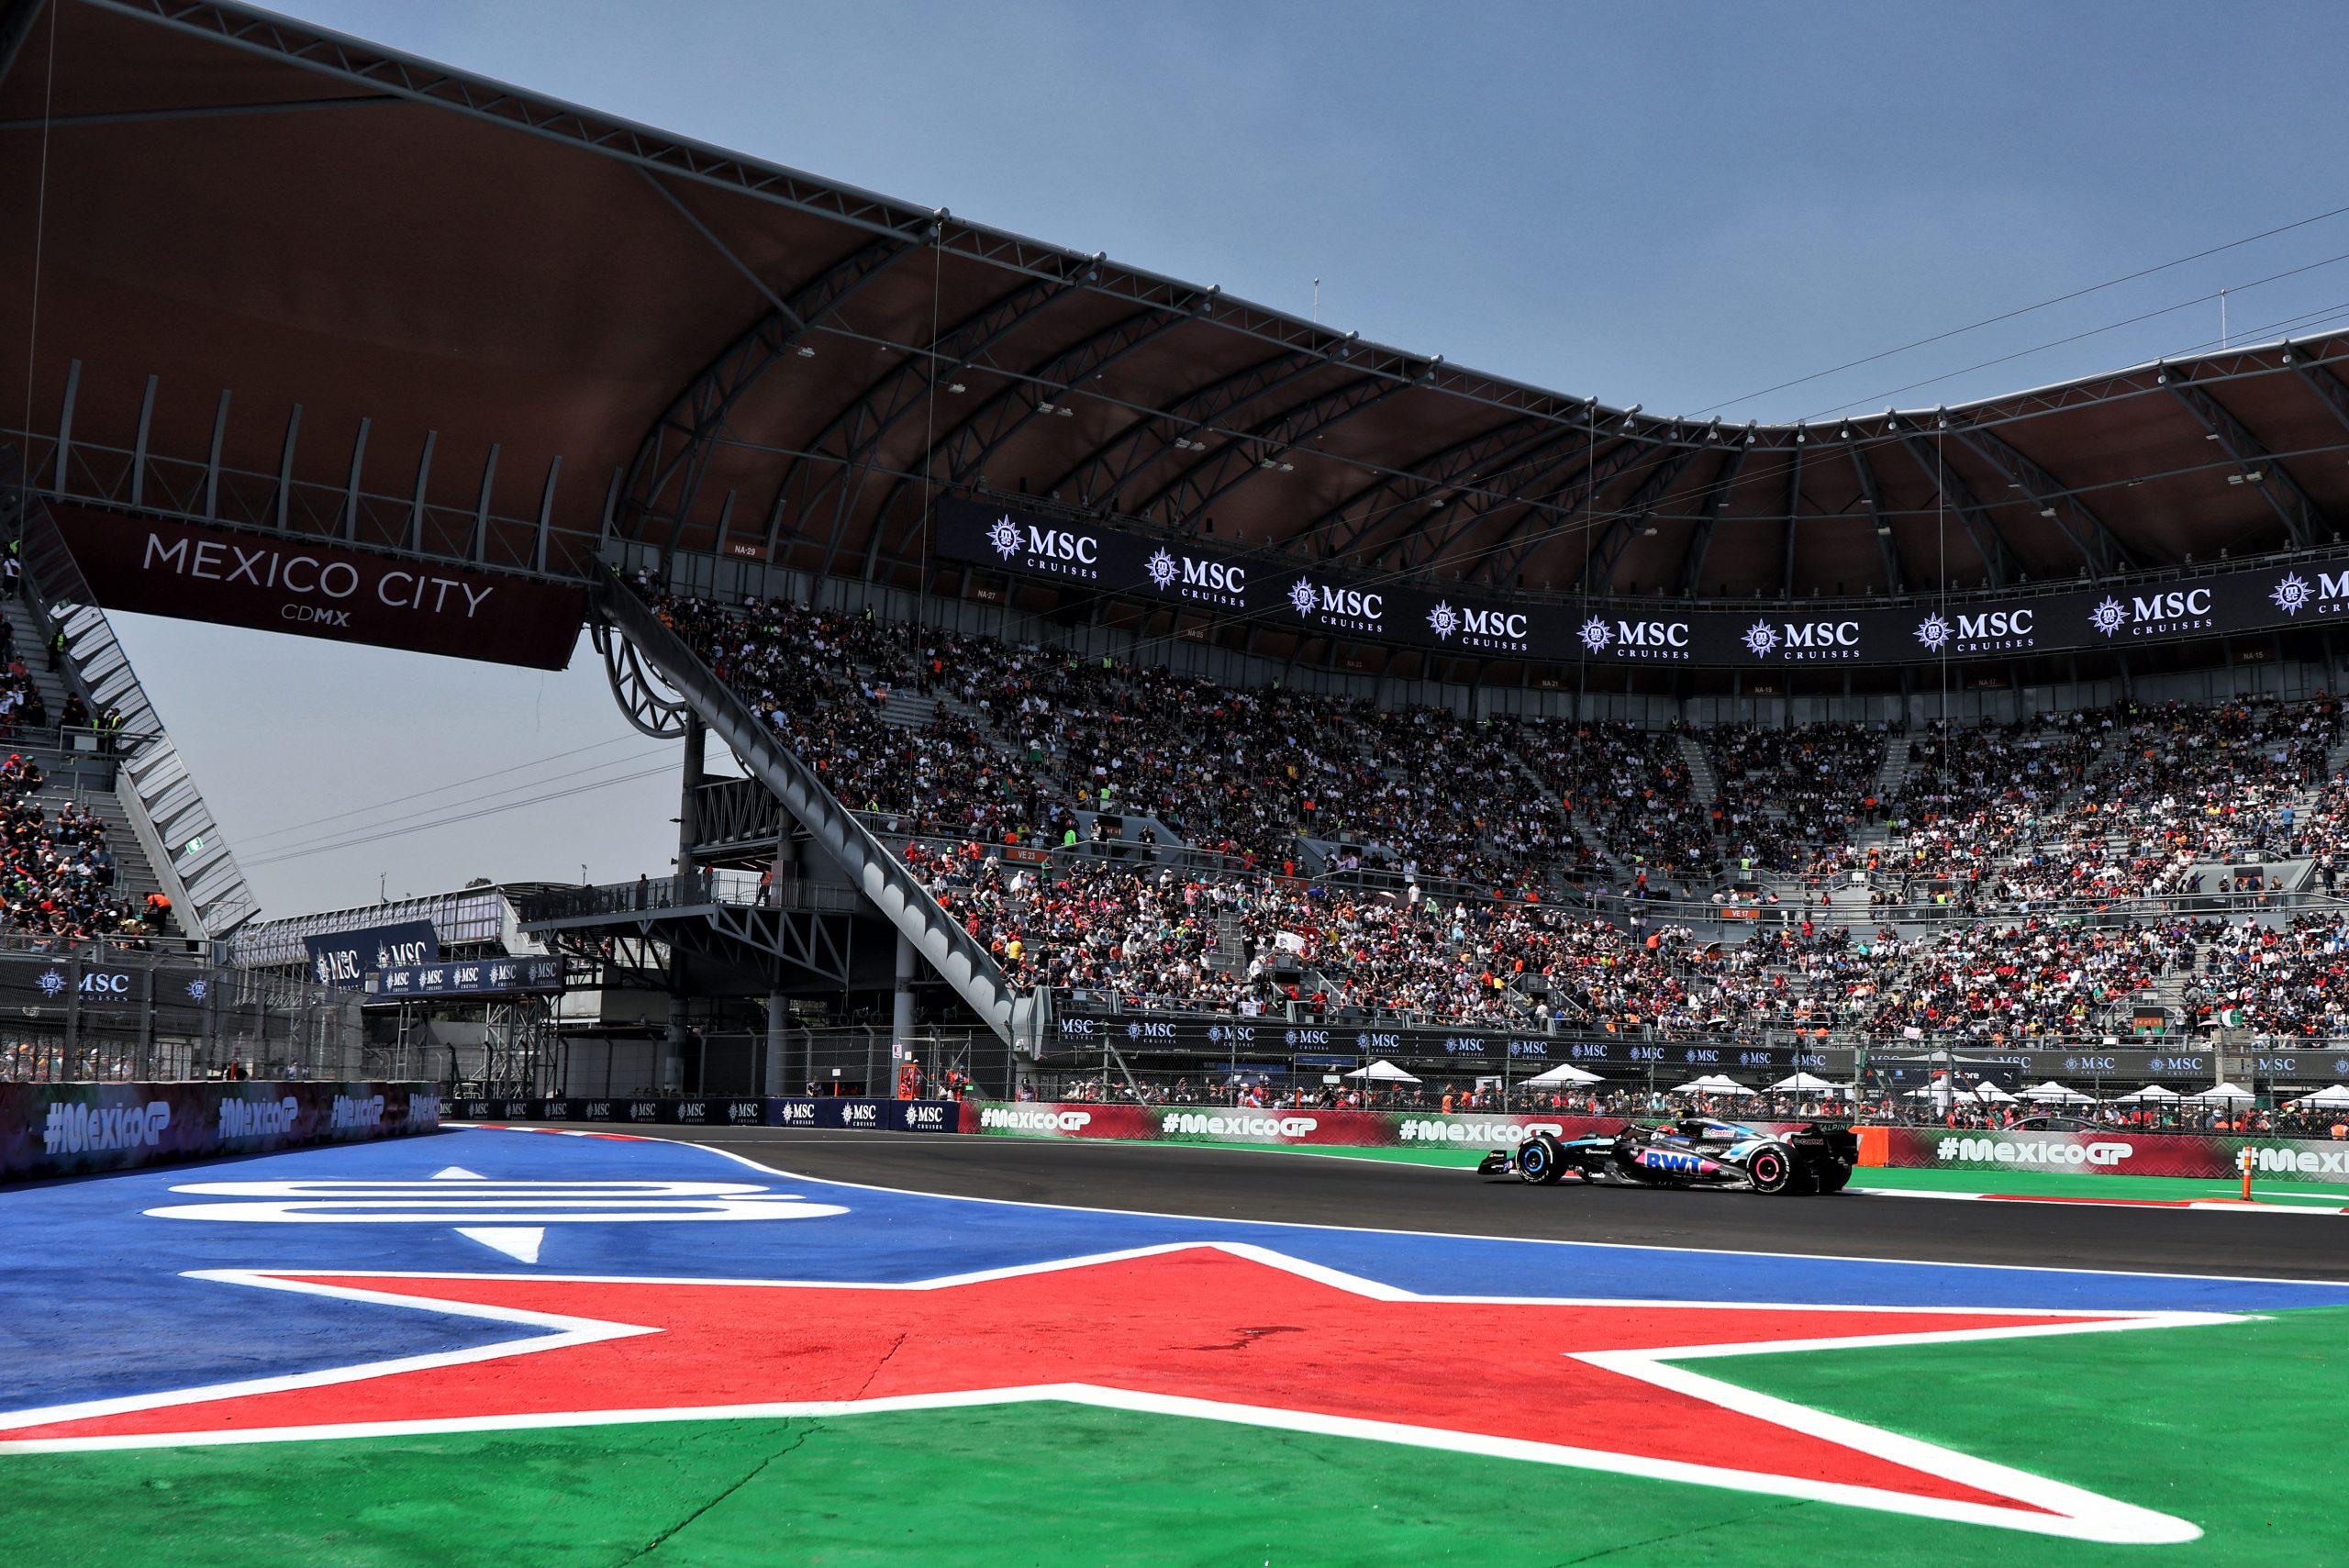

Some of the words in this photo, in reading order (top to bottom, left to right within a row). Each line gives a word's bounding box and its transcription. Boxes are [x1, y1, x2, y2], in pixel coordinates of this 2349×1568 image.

[1028, 525, 1097, 563] MSC
[143, 533, 359, 598] MEXICO
[378, 571, 494, 618] CITY
[1028, 559, 1097, 579] CRUISES
[1182, 556, 1245, 593] MSC
[1182, 588, 1245, 607] CRUISES
[1321, 585, 1383, 619] MSC
[2132, 589, 2211, 623] MSC
[2319, 603, 2349, 613] CR
[281, 603, 351, 627] CDMX
[1321, 616, 1383, 633] CRUISES
[1463, 607, 1527, 638] MSC
[1956, 609, 2033, 639] MSC
[2133, 618, 2212, 636] CRUISES
[1617, 621, 1688, 647] MSC
[1784, 622, 1859, 647] MSC
[1463, 637, 1527, 651] CRUISES
[1957, 639, 2033, 652] CRUISES
[1618, 649, 1689, 660] CRUISES
[1785, 650, 1859, 660] CRUISES
[328, 950, 360, 979] MSC
[538, 962, 557, 978] MSC
[427, 970, 443, 984] MSC
[460, 967, 479, 982] MSC
[499, 965, 516, 979] MSC
[78, 973, 129, 993] MSC
[394, 973, 409, 986] MSC
[1062, 1018, 1094, 1034] MSC
[1144, 1023, 1176, 1037] MSC
[1225, 1026, 1254, 1041] MSC
[1300, 1030, 1329, 1044] MSC
[1372, 1034, 1399, 1047] MSC
[1458, 1038, 1484, 1051] MSC
[1523, 1042, 1547, 1054] MSC
[1584, 1044, 1607, 1056] MSC
[1642, 1047, 1664, 1059] MSC
[1698, 1050, 1719, 1062] MSC
[1750, 1052, 1771, 1064] MSC
[1802, 1055, 1826, 1066] MSC
[2081, 1057, 2115, 1069] MSC
[2167, 1058, 2203, 1069] MSC
[2258, 1058, 2295, 1070] MSC
[1954, 1071, 1979, 1079] Sore
[440, 1102, 453, 1114] MSC
[475, 1102, 488, 1114] MSC
[512, 1103, 527, 1114] MSC
[552, 1103, 567, 1115] MSC
[594, 1103, 610, 1115] MSC
[639, 1103, 656, 1116] MSC
[687, 1103, 705, 1116] MSC
[738, 1103, 757, 1117] MSC
[793, 1104, 814, 1119] MSC
[854, 1105, 876, 1121] MSC
[918, 1106, 943, 1123] MSC
[218, 1096, 298, 1139] #MexicoGP
[980, 1108, 1091, 1131] #MexicoGP
[44, 1101, 170, 1155] #MexicoGP
[1163, 1113, 1317, 1137] #MexicoGP
[1399, 1120, 1563, 1142] #MexicoGP
[1937, 1137, 2133, 1165] #MexicoGP
